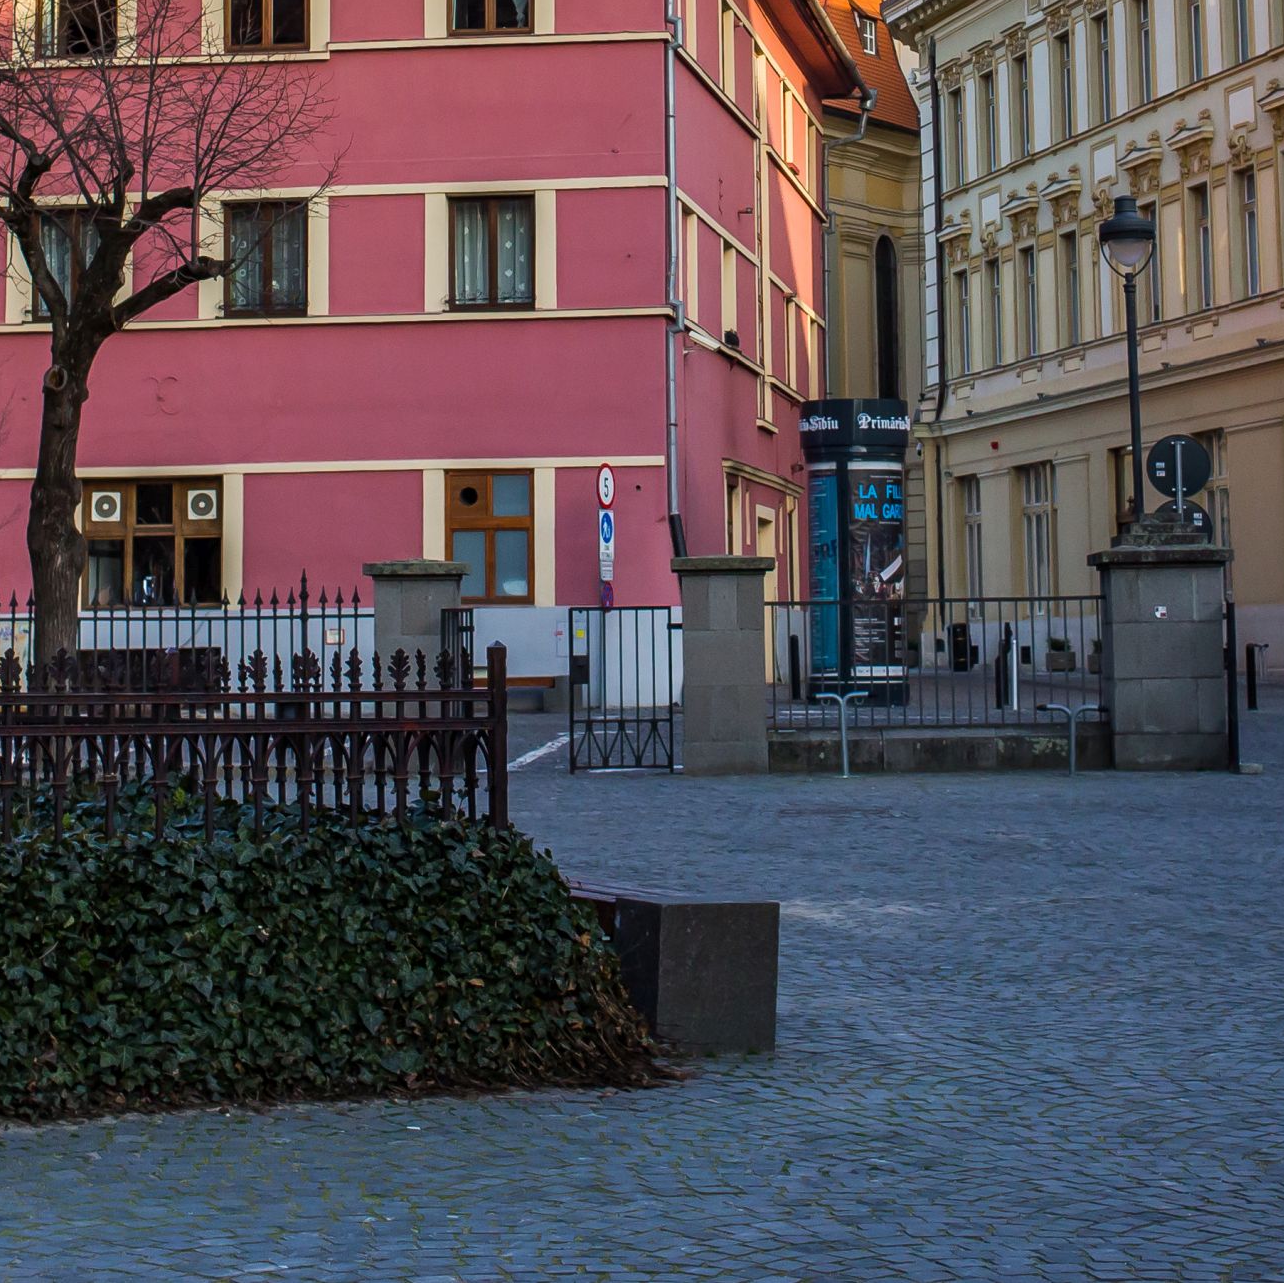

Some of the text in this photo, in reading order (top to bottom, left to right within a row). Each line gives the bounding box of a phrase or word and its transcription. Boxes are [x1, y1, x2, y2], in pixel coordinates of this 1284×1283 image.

[604, 477, 609, 498] 5
[859, 484, 878, 499] LA
[854, 503, 878, 520] MAL
